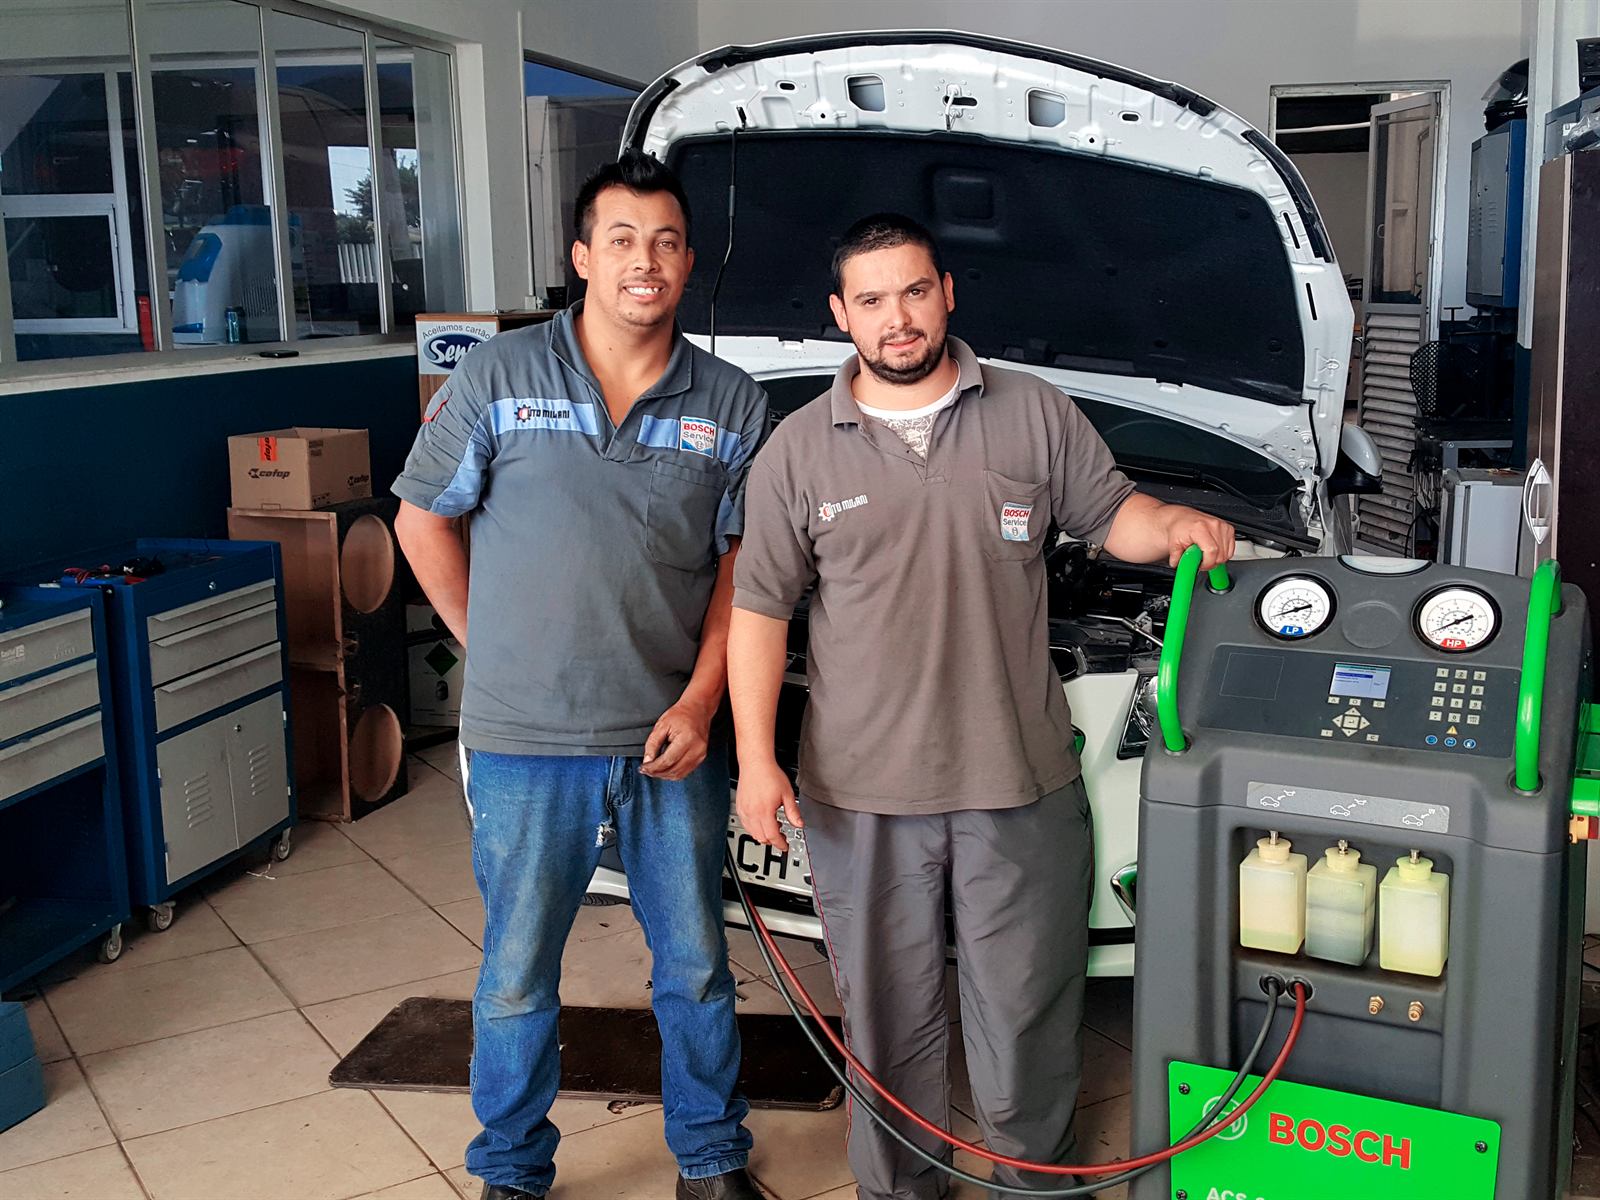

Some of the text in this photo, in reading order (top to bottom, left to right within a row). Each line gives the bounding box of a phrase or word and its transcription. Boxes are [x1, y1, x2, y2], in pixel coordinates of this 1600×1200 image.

[422, 324, 491, 340] Aceitamos cartão
[430, 339, 481, 364] Sen
[683, 423, 715, 436] BOSCH
[683, 431, 714, 444] Service
[1004, 509, 1030, 518] BOSCH
[1003, 518, 1027, 527] Service
[1286, 626, 1299, 634] LP
[1446, 639, 1462, 647] HP
[1268, 1111, 1411, 1170] BOSCH
